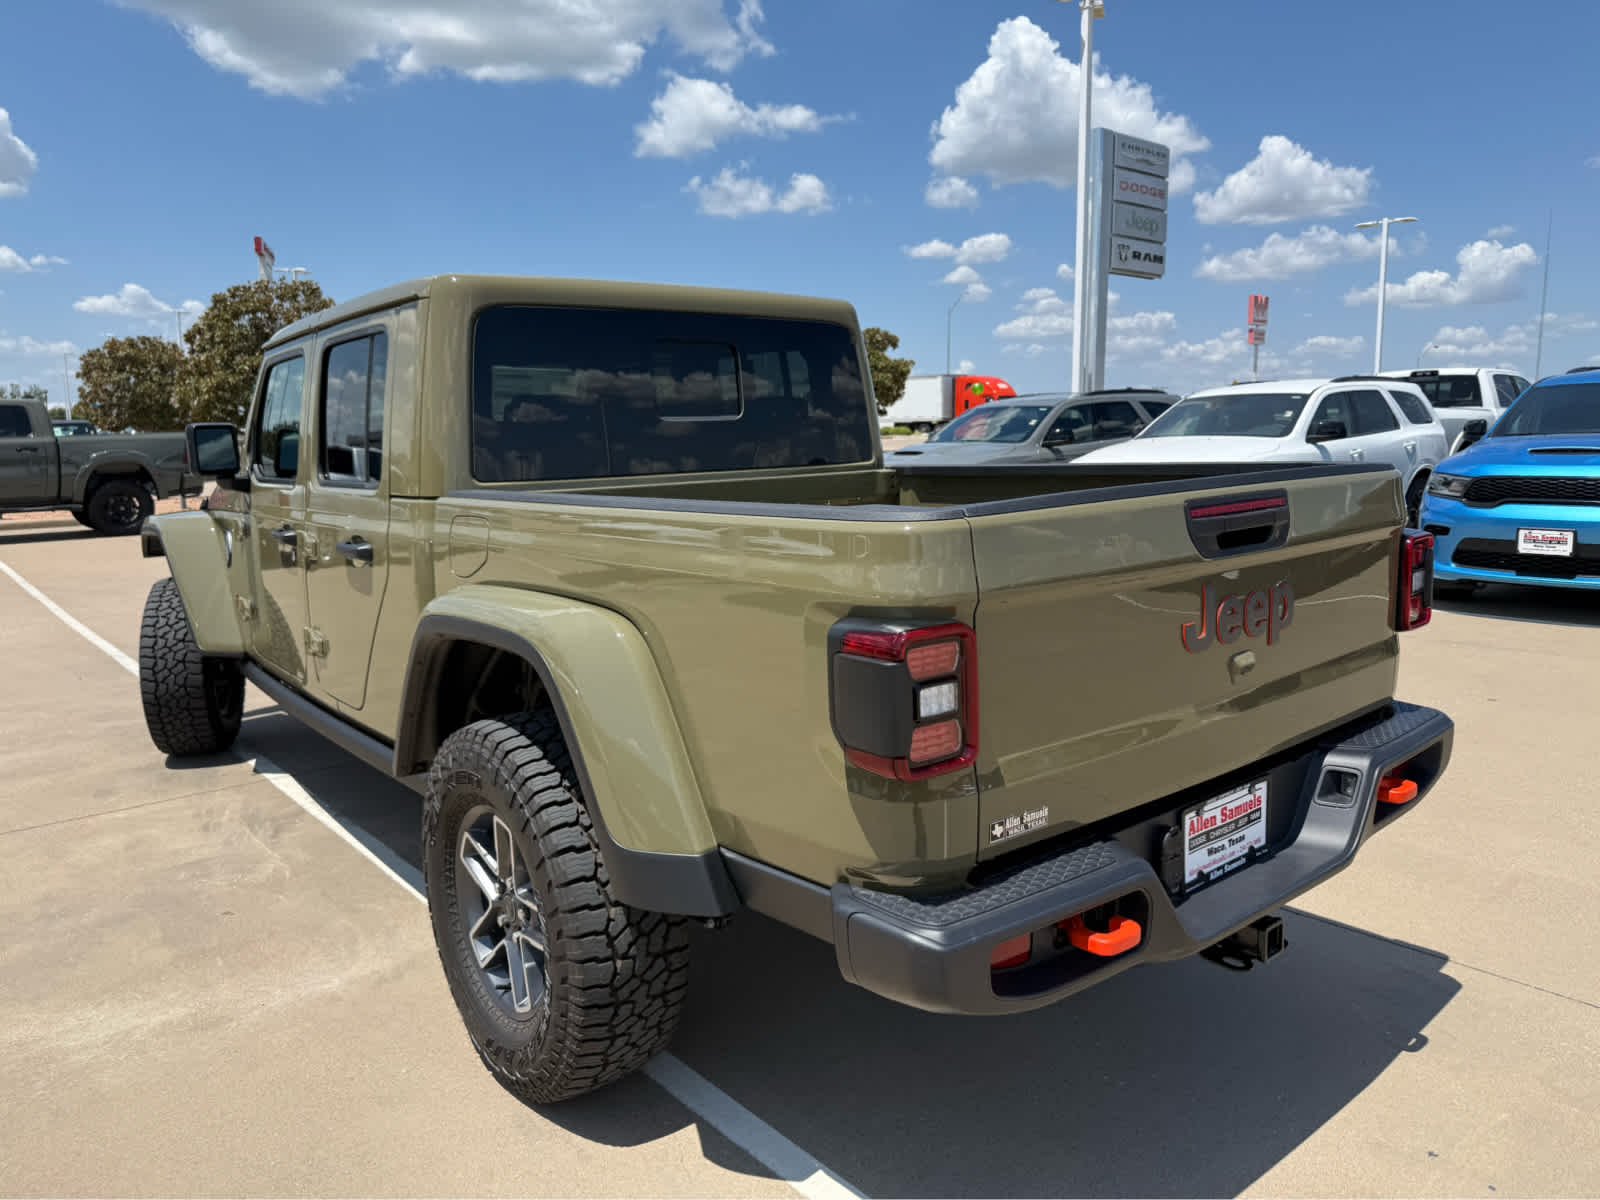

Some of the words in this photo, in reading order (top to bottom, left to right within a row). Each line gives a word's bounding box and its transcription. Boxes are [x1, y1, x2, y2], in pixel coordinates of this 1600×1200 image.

[1121, 141, 1167, 159] CHRYSLER
[1119, 180, 1165, 200] DODGE
[1125, 208, 1160, 237] Jeep
[1131, 250, 1164, 265] RAM
[1181, 580, 1295, 655] Jeep
[1006, 816, 1021, 829] Allen
[1023, 806, 1048, 823] Samuels
[1189, 814, 1217, 836] Allen
[1220, 793, 1262, 824] Samuels
[1209, 821, 1236, 840] CHRYSLER
[1250, 811, 1260, 822] RAM
[1228, 833, 1246, 847] Texas
